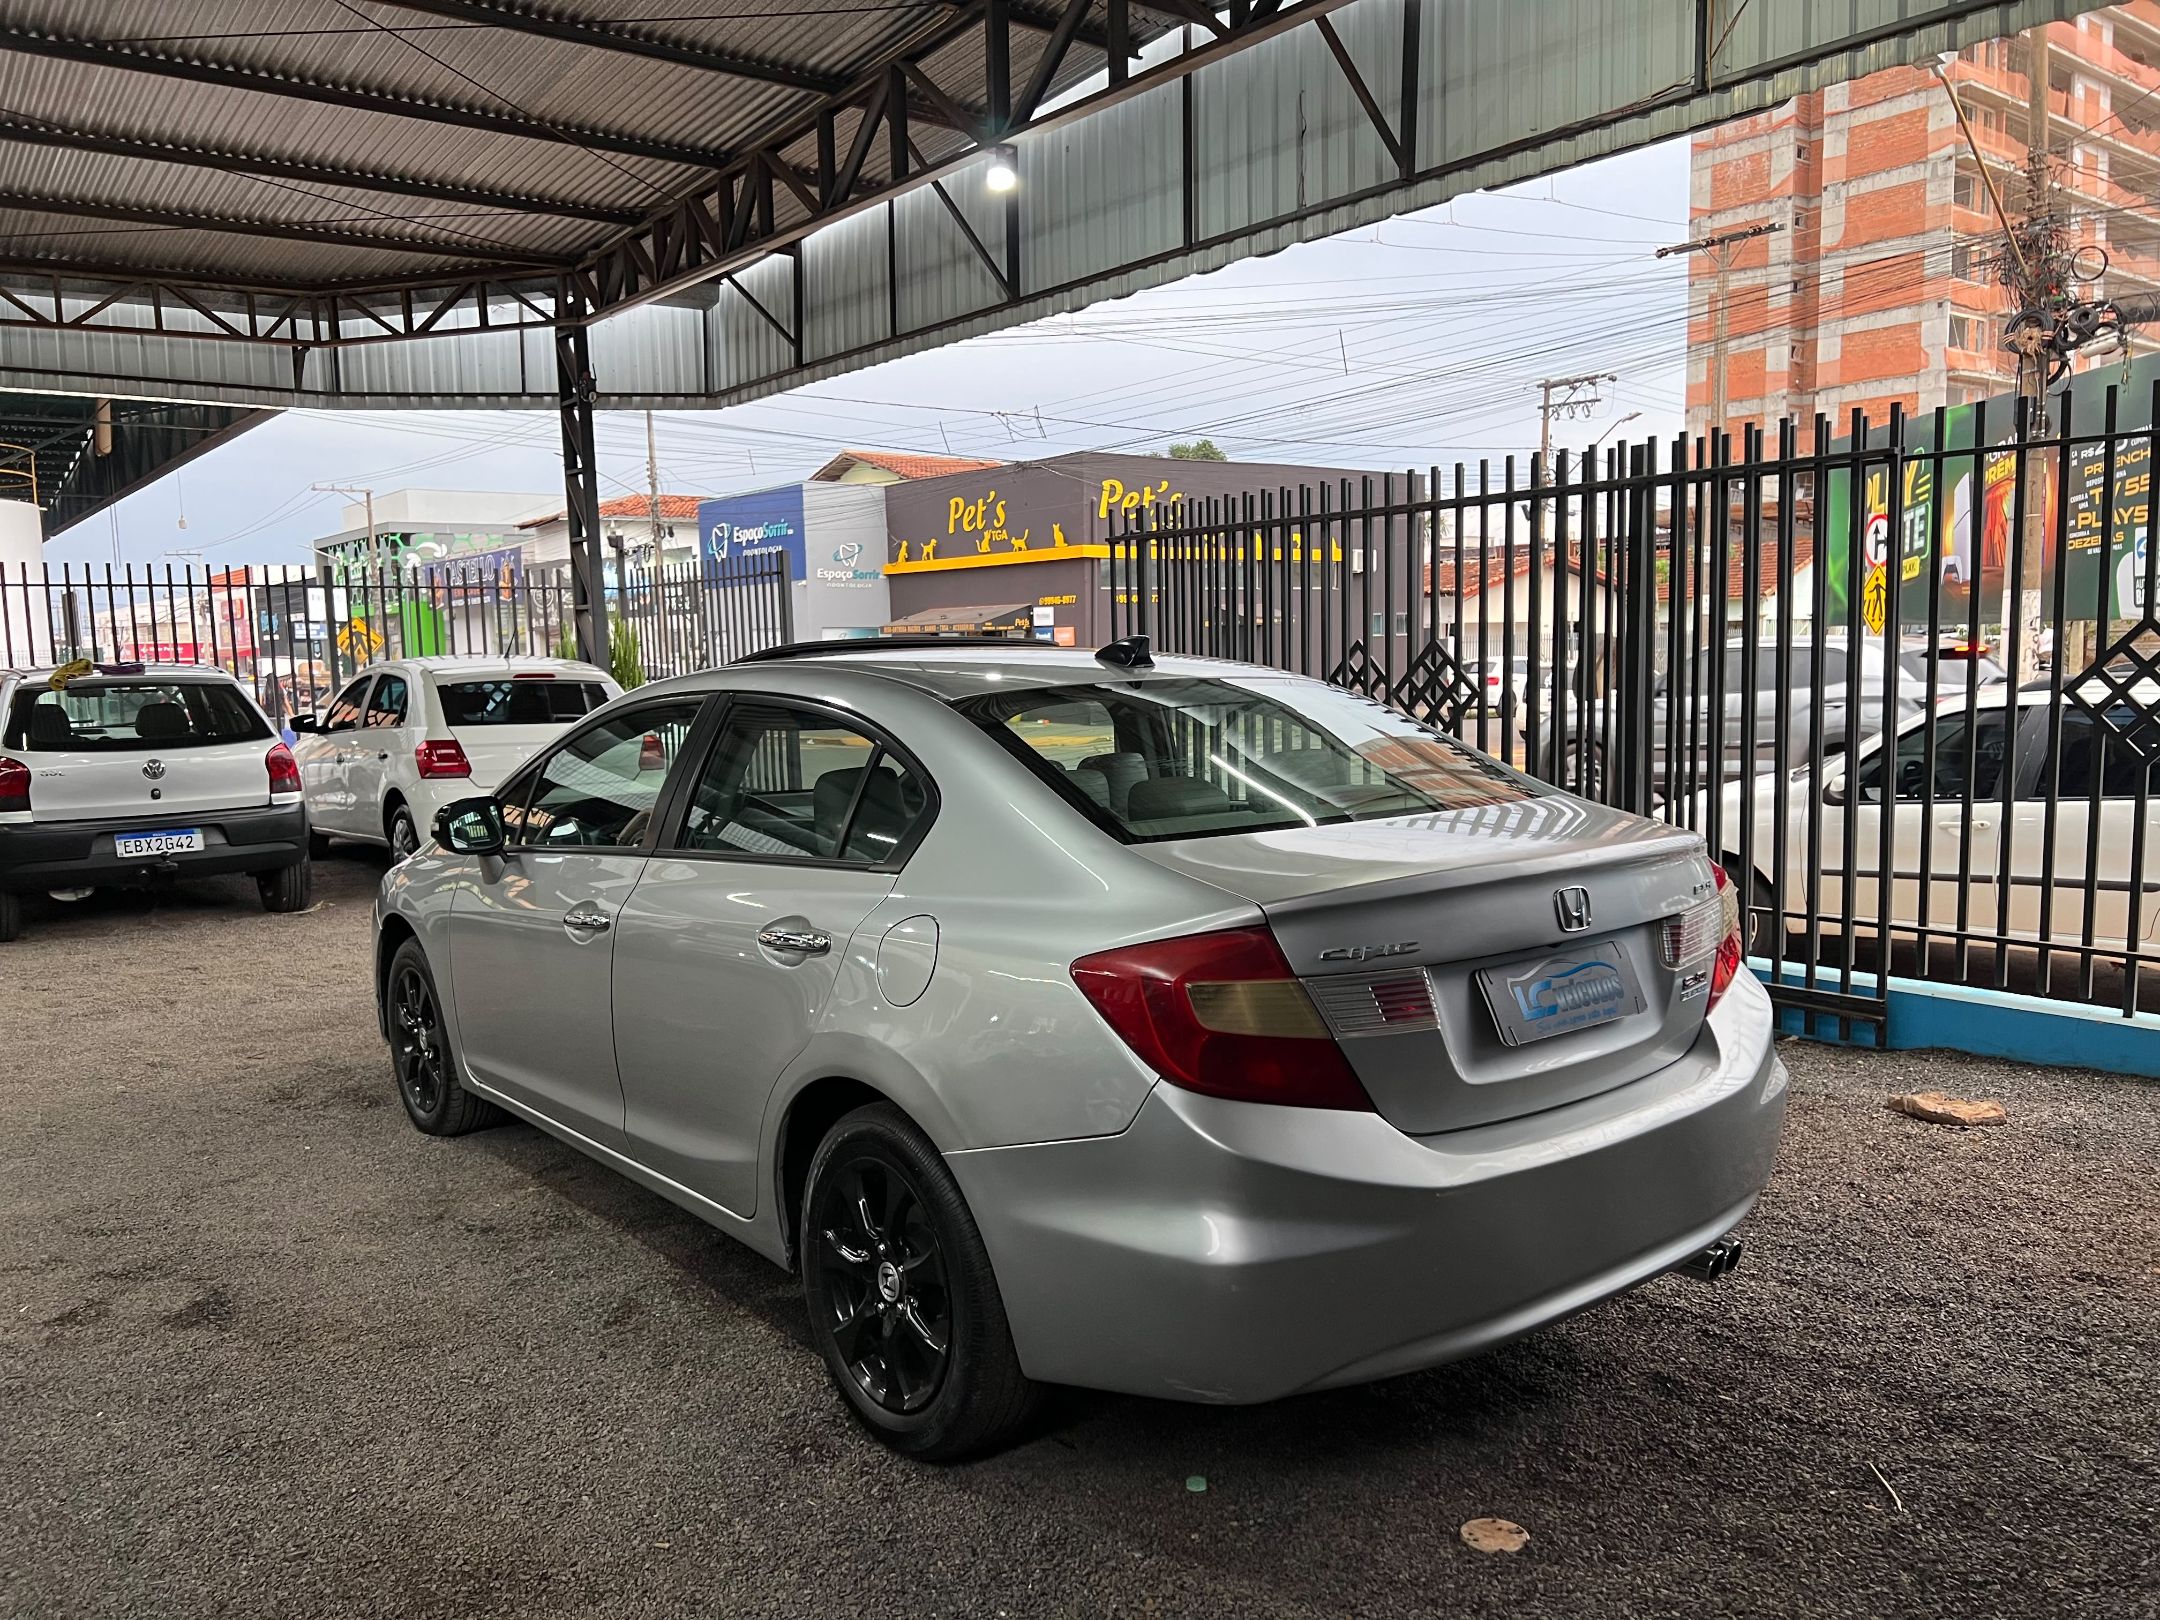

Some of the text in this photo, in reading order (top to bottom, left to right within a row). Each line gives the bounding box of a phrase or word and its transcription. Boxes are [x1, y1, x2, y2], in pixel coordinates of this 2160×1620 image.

[948, 490, 1006, 534] Pet's
[2068, 531, 2125, 550] DEZES
[123, 835, 195, 855] EBX2G42
